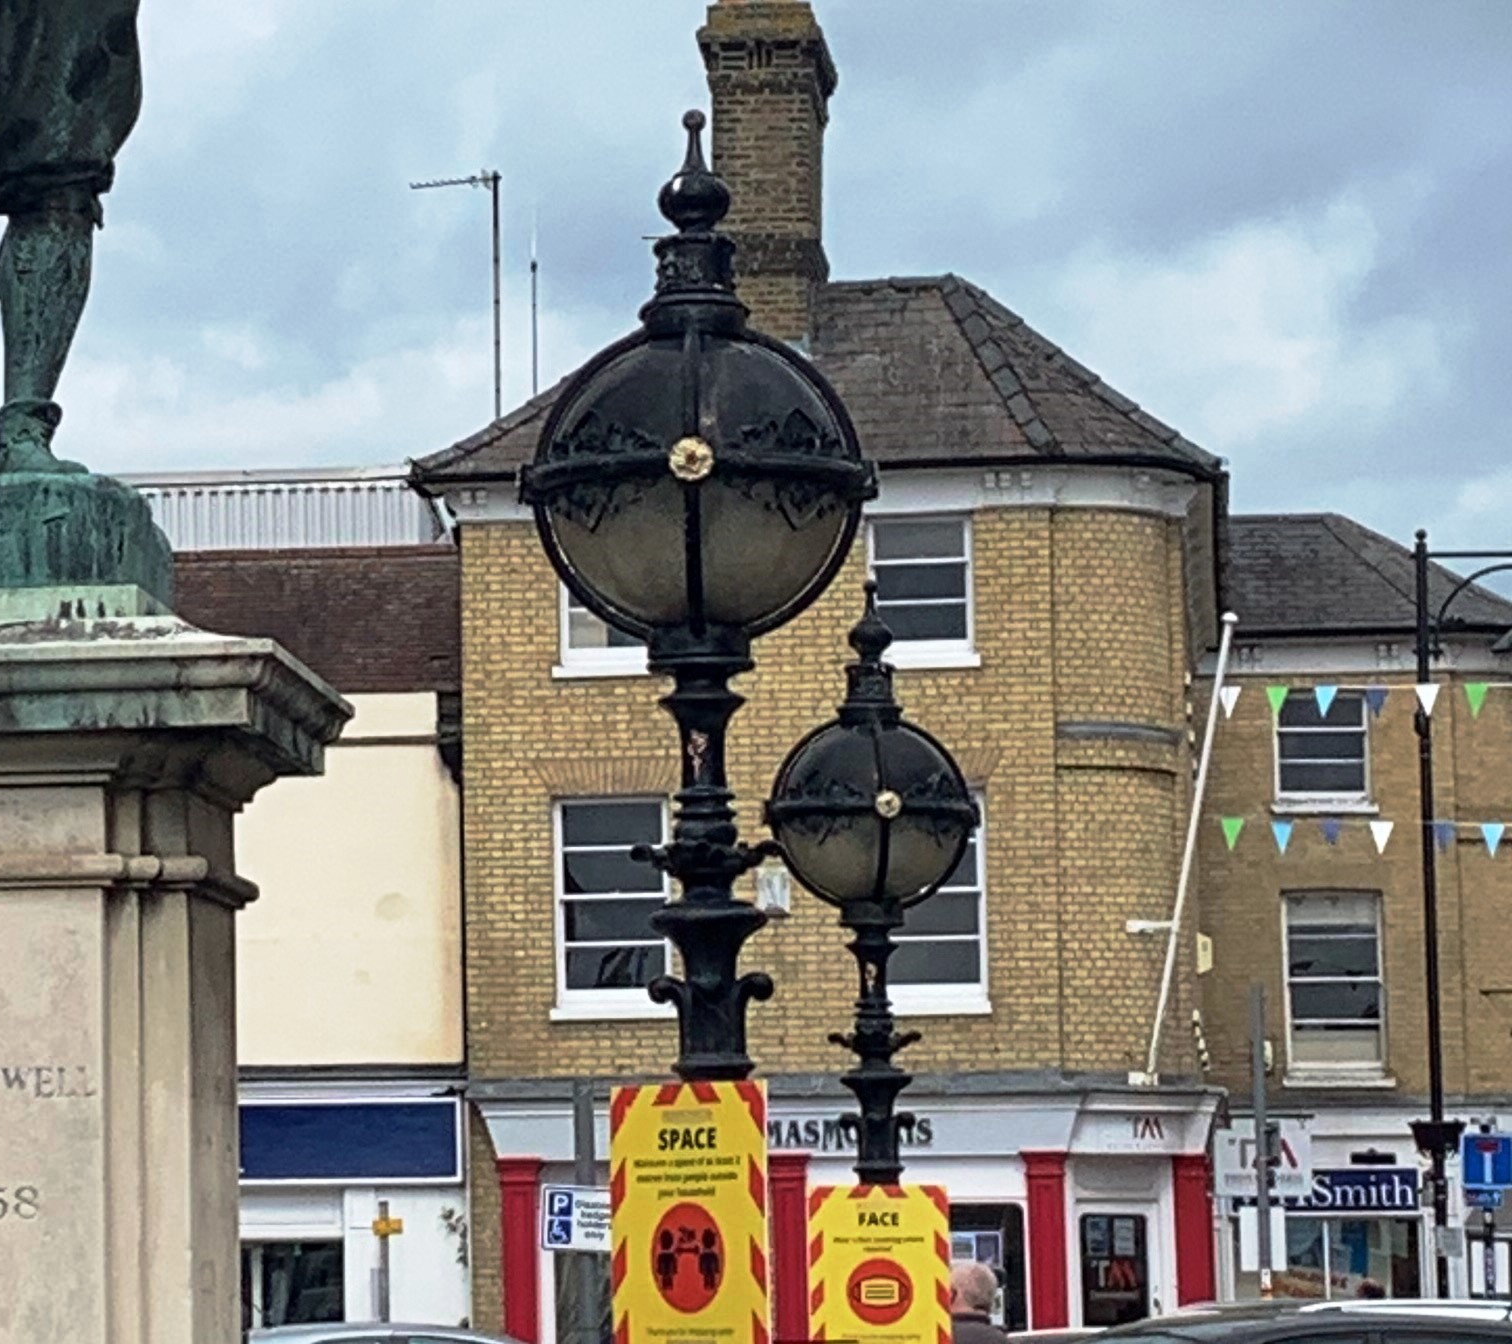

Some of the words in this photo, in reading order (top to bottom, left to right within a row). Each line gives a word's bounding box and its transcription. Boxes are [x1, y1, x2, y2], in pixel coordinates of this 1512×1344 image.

[658, 1127, 717, 1150] SPACE
[1281, 1173, 1415, 1207] Smith
[858, 1212, 900, 1227] FACE
